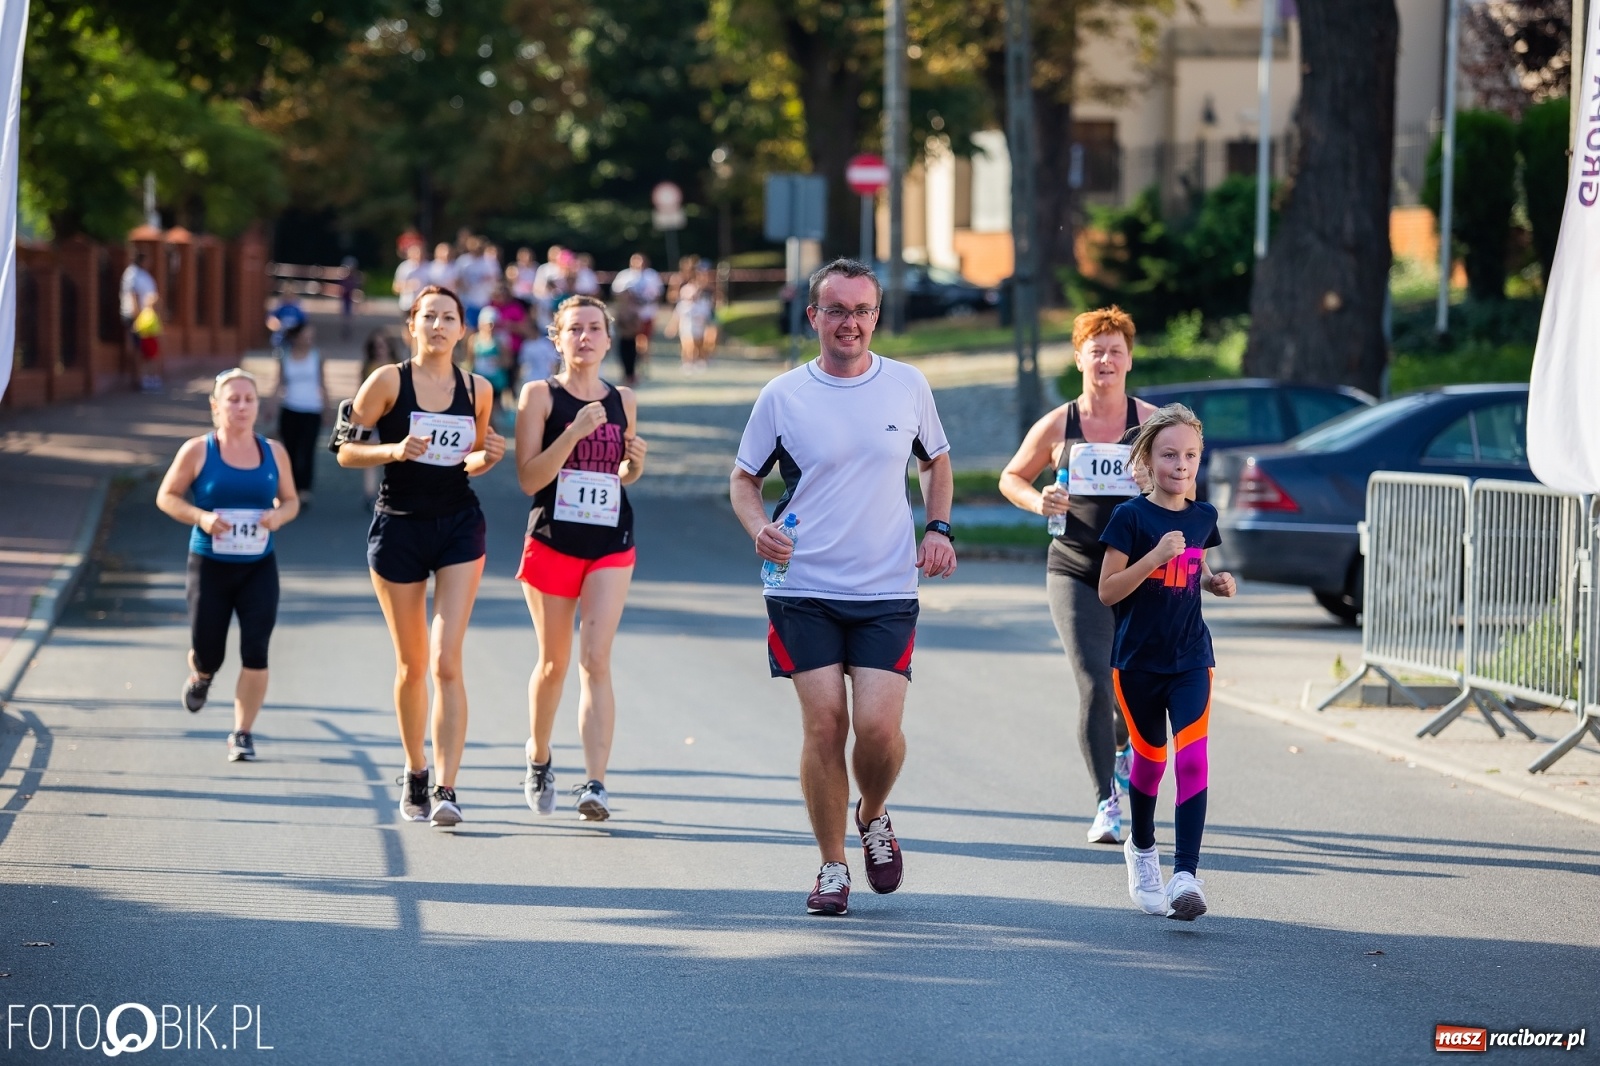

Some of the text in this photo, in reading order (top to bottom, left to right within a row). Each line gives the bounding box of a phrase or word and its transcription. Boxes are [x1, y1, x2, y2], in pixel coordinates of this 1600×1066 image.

[430, 429, 461, 447] 162
[1091, 459, 1123, 476] 108
[578, 487, 608, 505] 113
[232, 523, 257, 537] 142
